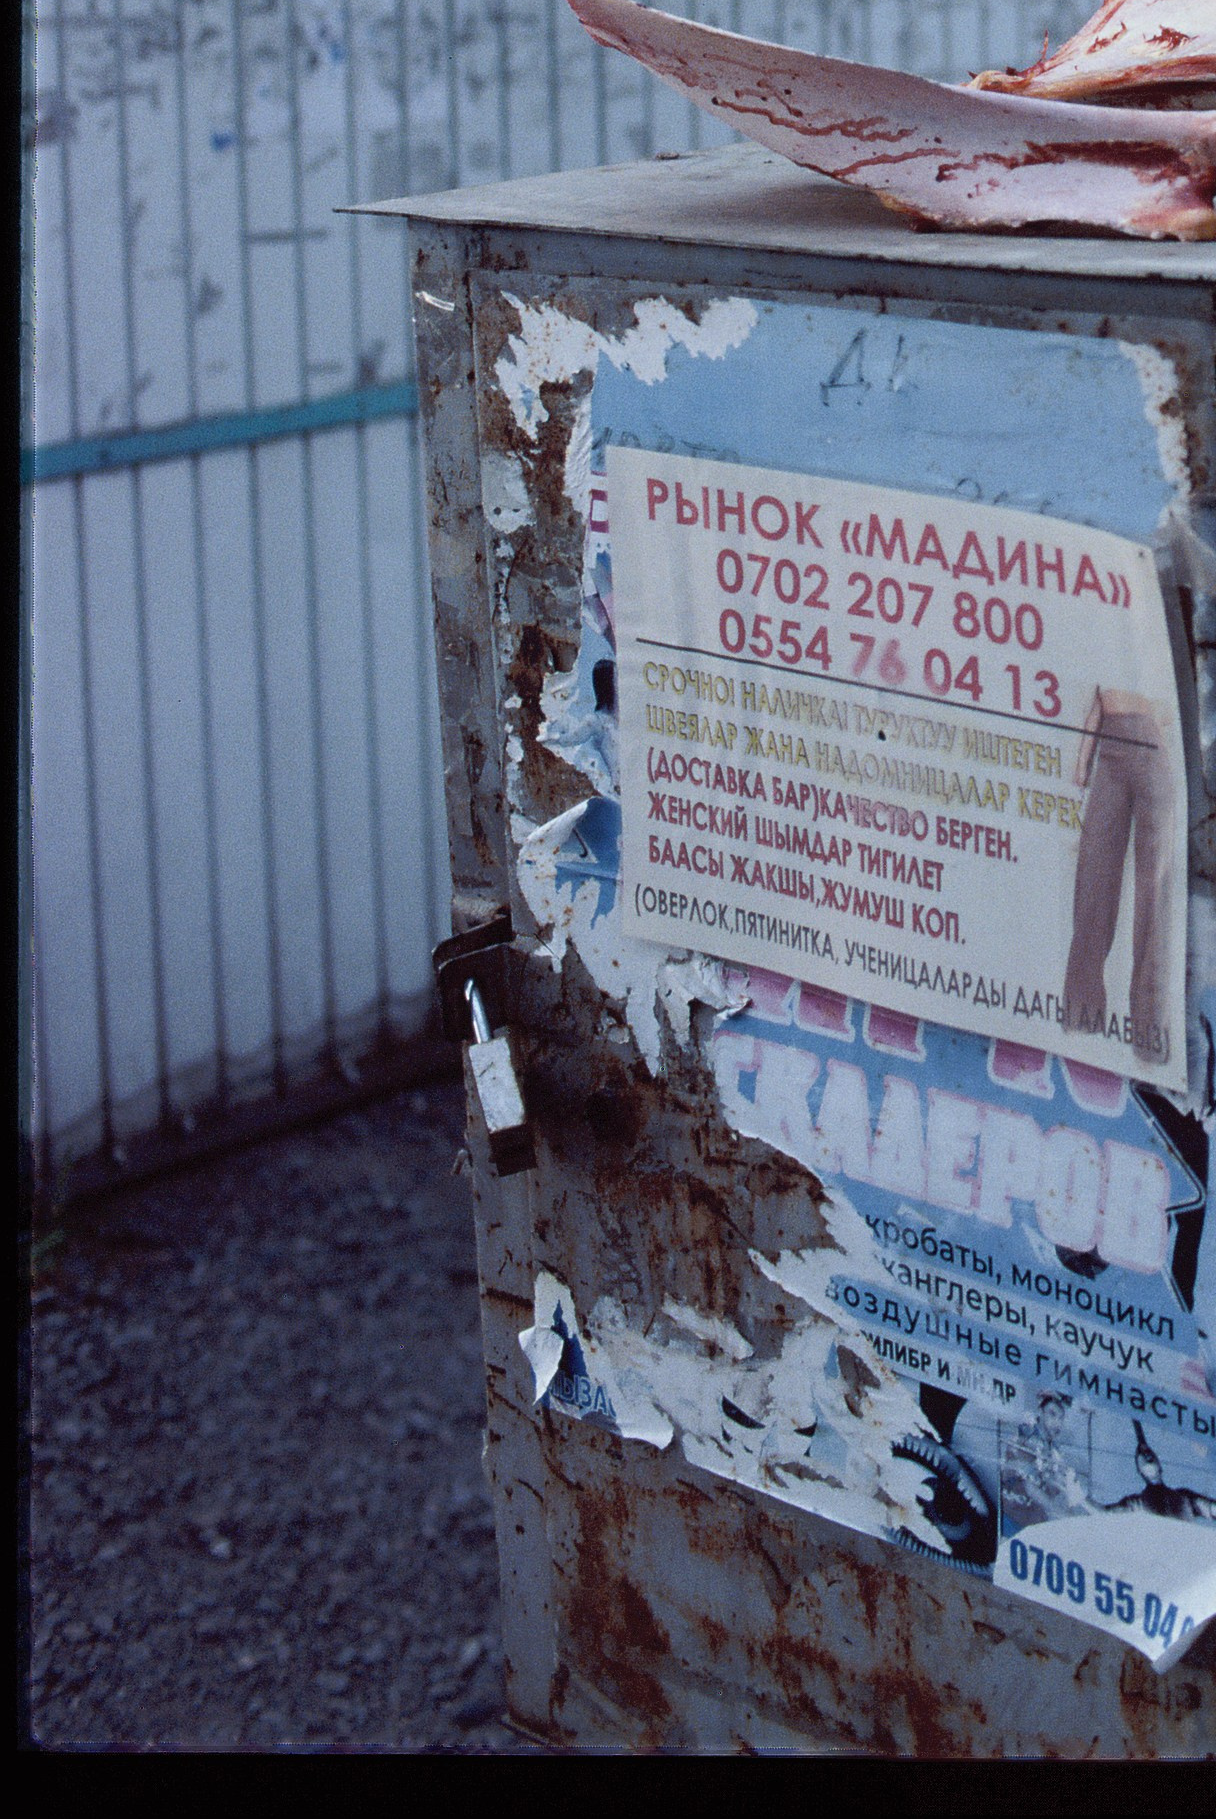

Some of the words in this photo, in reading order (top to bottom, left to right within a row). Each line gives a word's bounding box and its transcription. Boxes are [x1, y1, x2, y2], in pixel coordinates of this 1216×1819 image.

[646, 478, 824, 549] РЫНОК
[840, 513, 1131, 609] «МАДИНА»
[716, 548, 830, 610] 0702
[848, 571, 934, 628] 207
[953, 591, 1044, 651] 800
[719, 608, 832, 671] 0554
[850, 632, 907, 685] 76
[923, 648, 983, 702] 04
[1005, 664, 1062, 718] 13
[643, 661, 735, 707] СРОЧНО!
[964, 727, 1062, 779] ИШТЕГЕН
[646, 703, 737, 751] ШВЕЯЛАР
[743, 725, 810, 768] ЖАНА
[1017, 786, 1086, 831] КЕРЕК
[647, 746, 767, 802] (ДОСТАВКА
[935, 815, 1018, 863] БЕРГЕН.
[647, 790, 748, 841] ЖЕНСКИЙ
[755, 815, 852, 867] ШЫМДАР
[857, 842, 944, 892] ТИГИЛЕТ
[648, 835, 724, 879] БААСЫ
[912, 903, 966, 945] КОП.
[844, 938, 1007, 1009] УЧЕНИЦАЛАРДЫ
[1012, 985, 1072, 1027] ДАГЫ
[865, 1213, 1002, 1286] кробаты,
[1012, 1264, 1174, 1341] моноцикл
[1036, 1353, 1216, 1438] гимнасты
[1046, 1314, 1154, 1373] каучук
[1010, 1538, 1086, 1604] 0709
[1094, 1571, 1135, 1624] 55
[1143, 1592, 1179, 1649] 04
